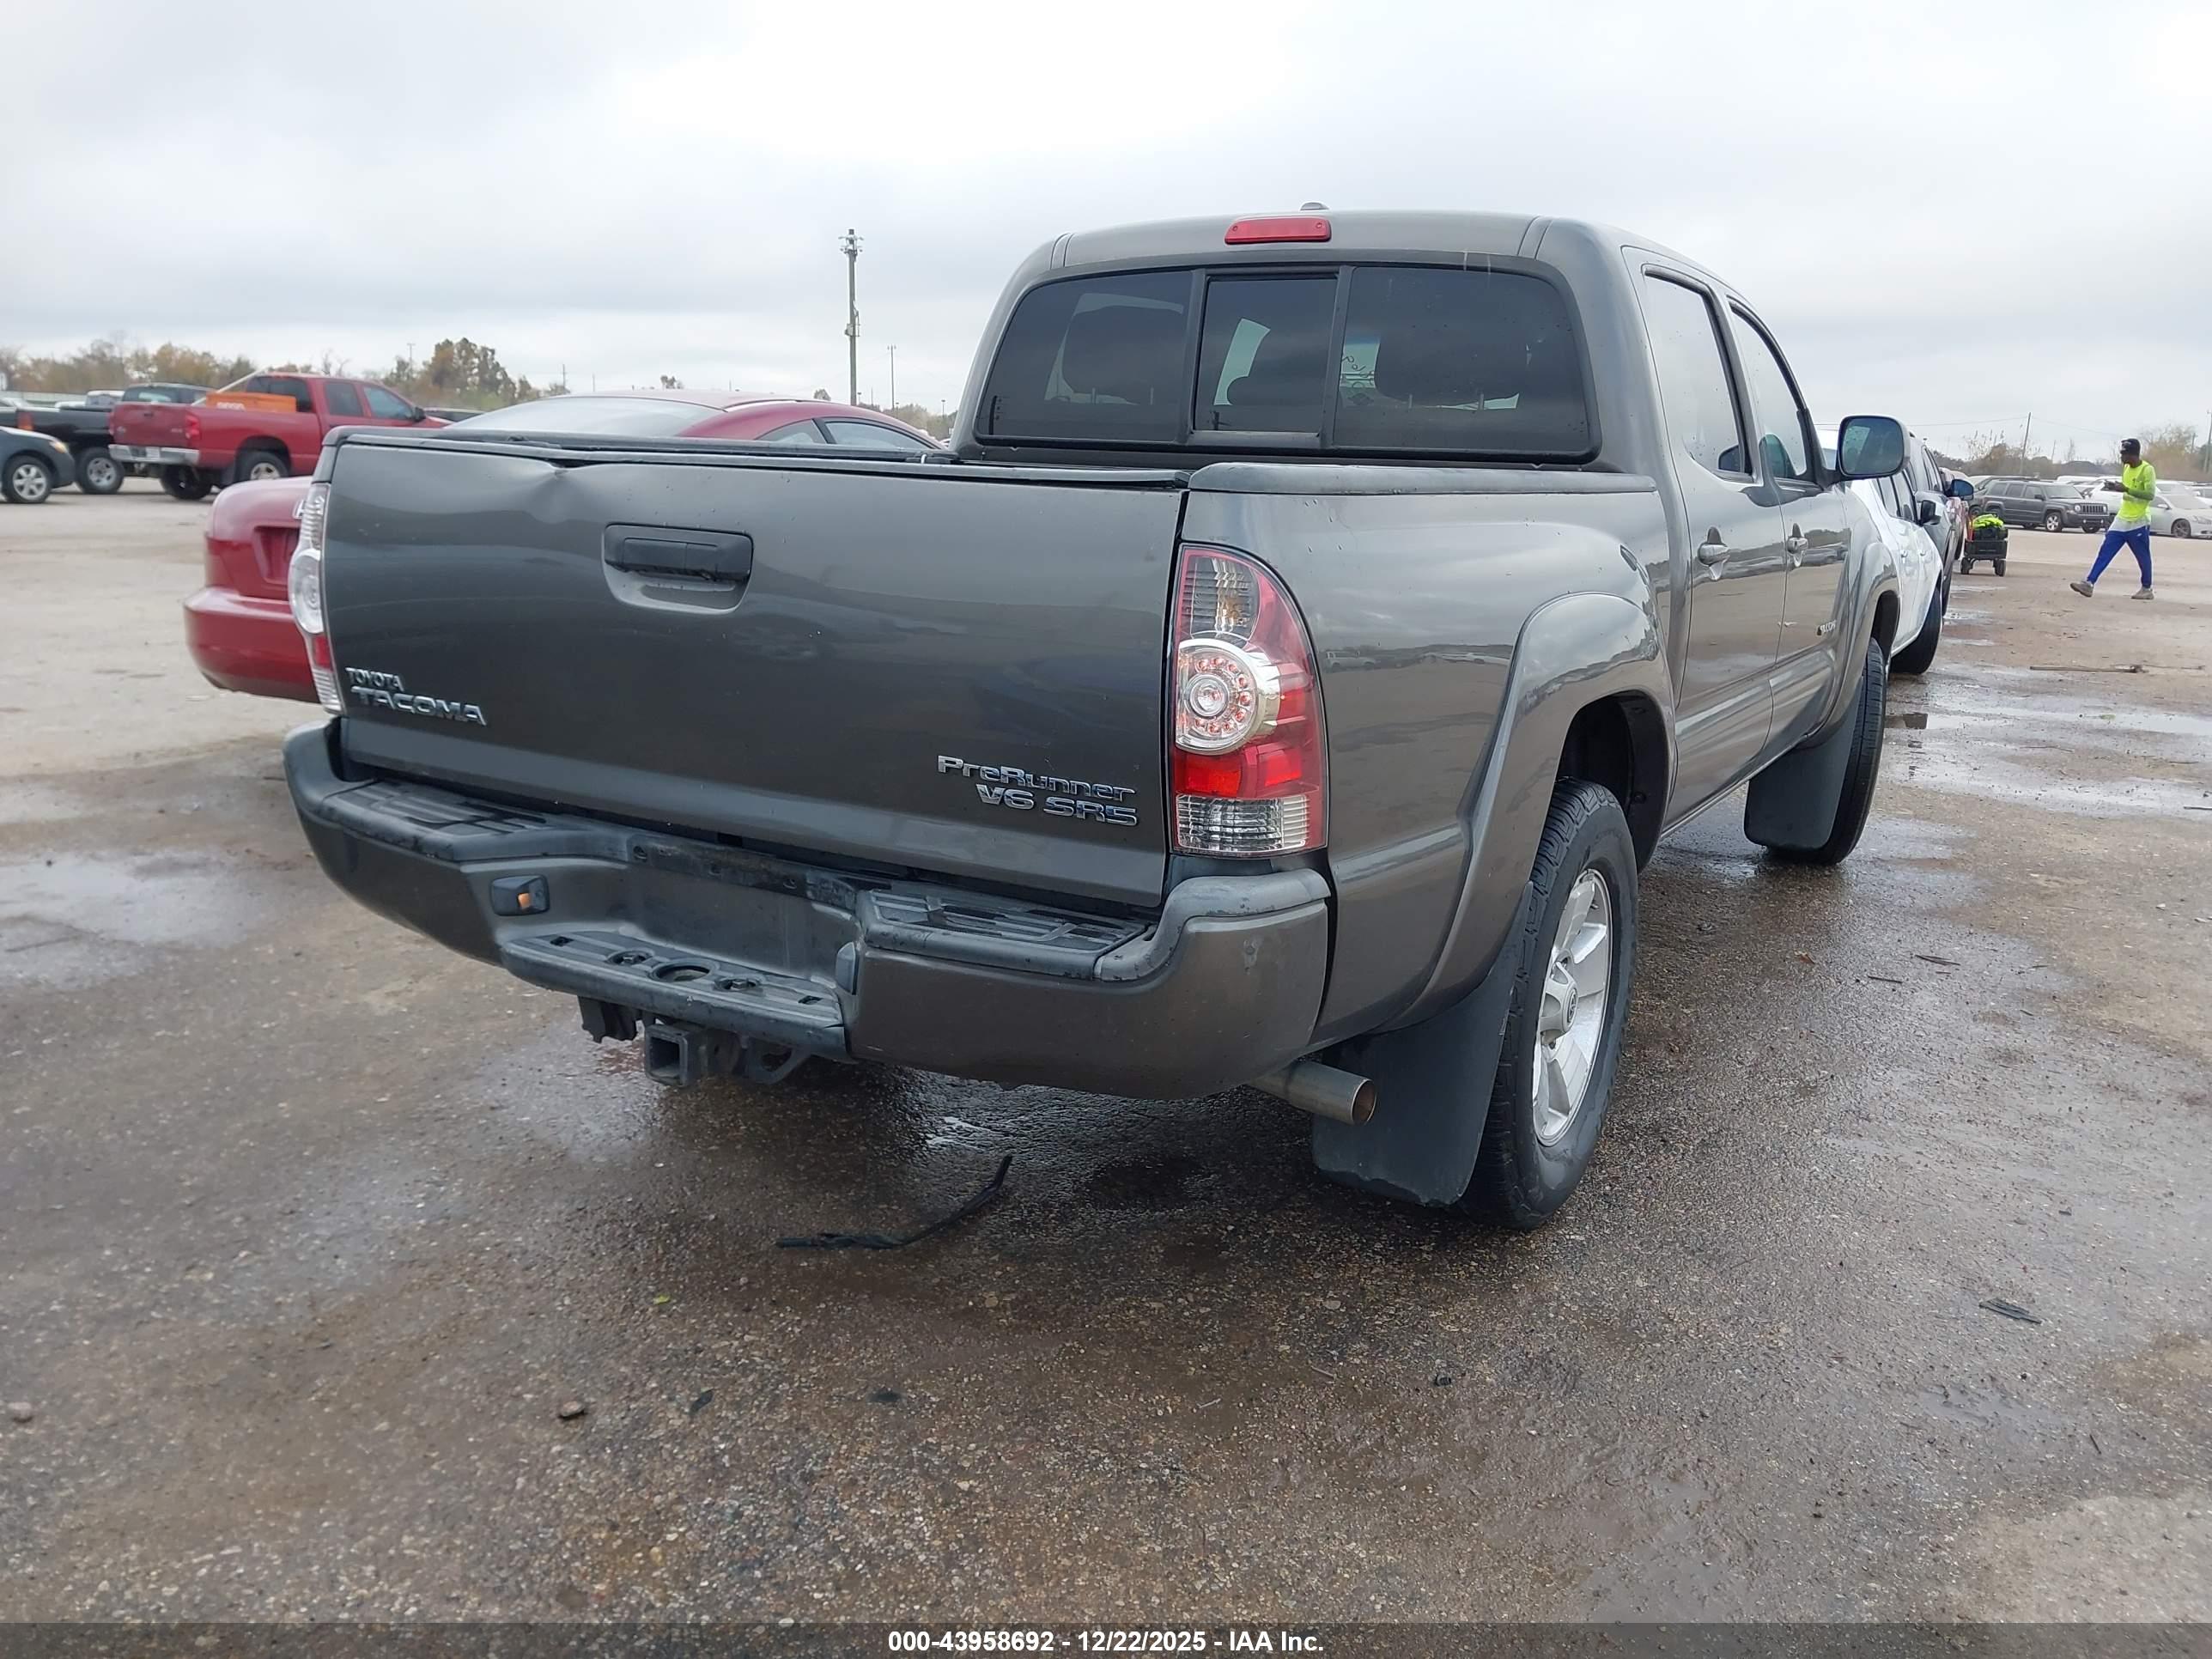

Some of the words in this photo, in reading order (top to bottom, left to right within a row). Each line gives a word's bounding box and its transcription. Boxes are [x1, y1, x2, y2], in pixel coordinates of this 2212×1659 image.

[345, 667, 404, 691] TOYOTA
[350, 686, 487, 726] TACOMA
[937, 755, 1136, 802] PreRunner
[975, 784, 1035, 810] V6
[1043, 796, 1139, 826] SR5
